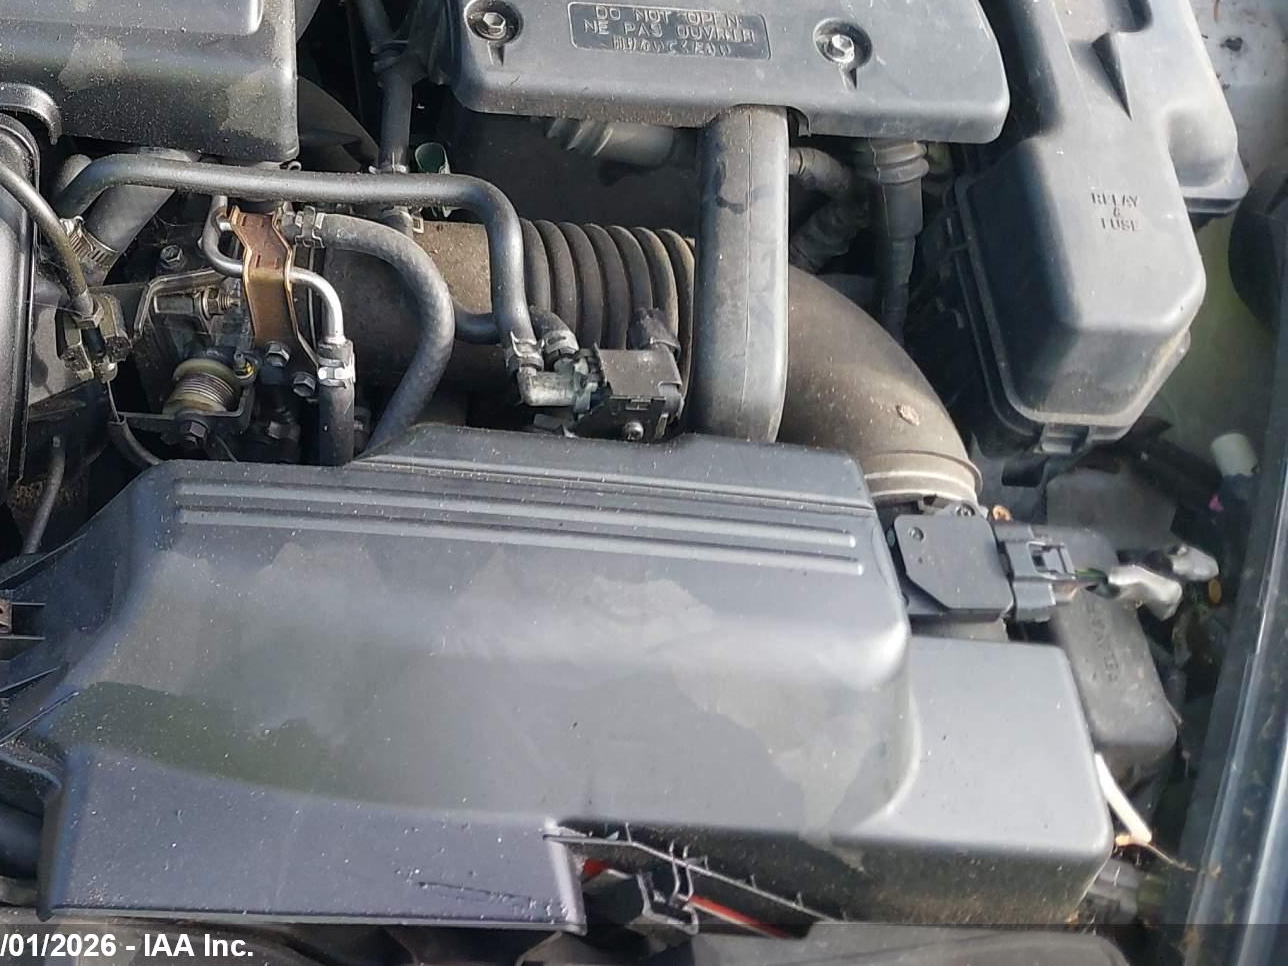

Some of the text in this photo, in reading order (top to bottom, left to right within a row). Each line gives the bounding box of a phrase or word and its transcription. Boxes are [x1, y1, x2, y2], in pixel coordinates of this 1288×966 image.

[595, 5, 620, 21] DO
[635, 8, 671, 23] NOT
[584, 19, 609, 35] NE
[624, 22, 662, 38] PAS
